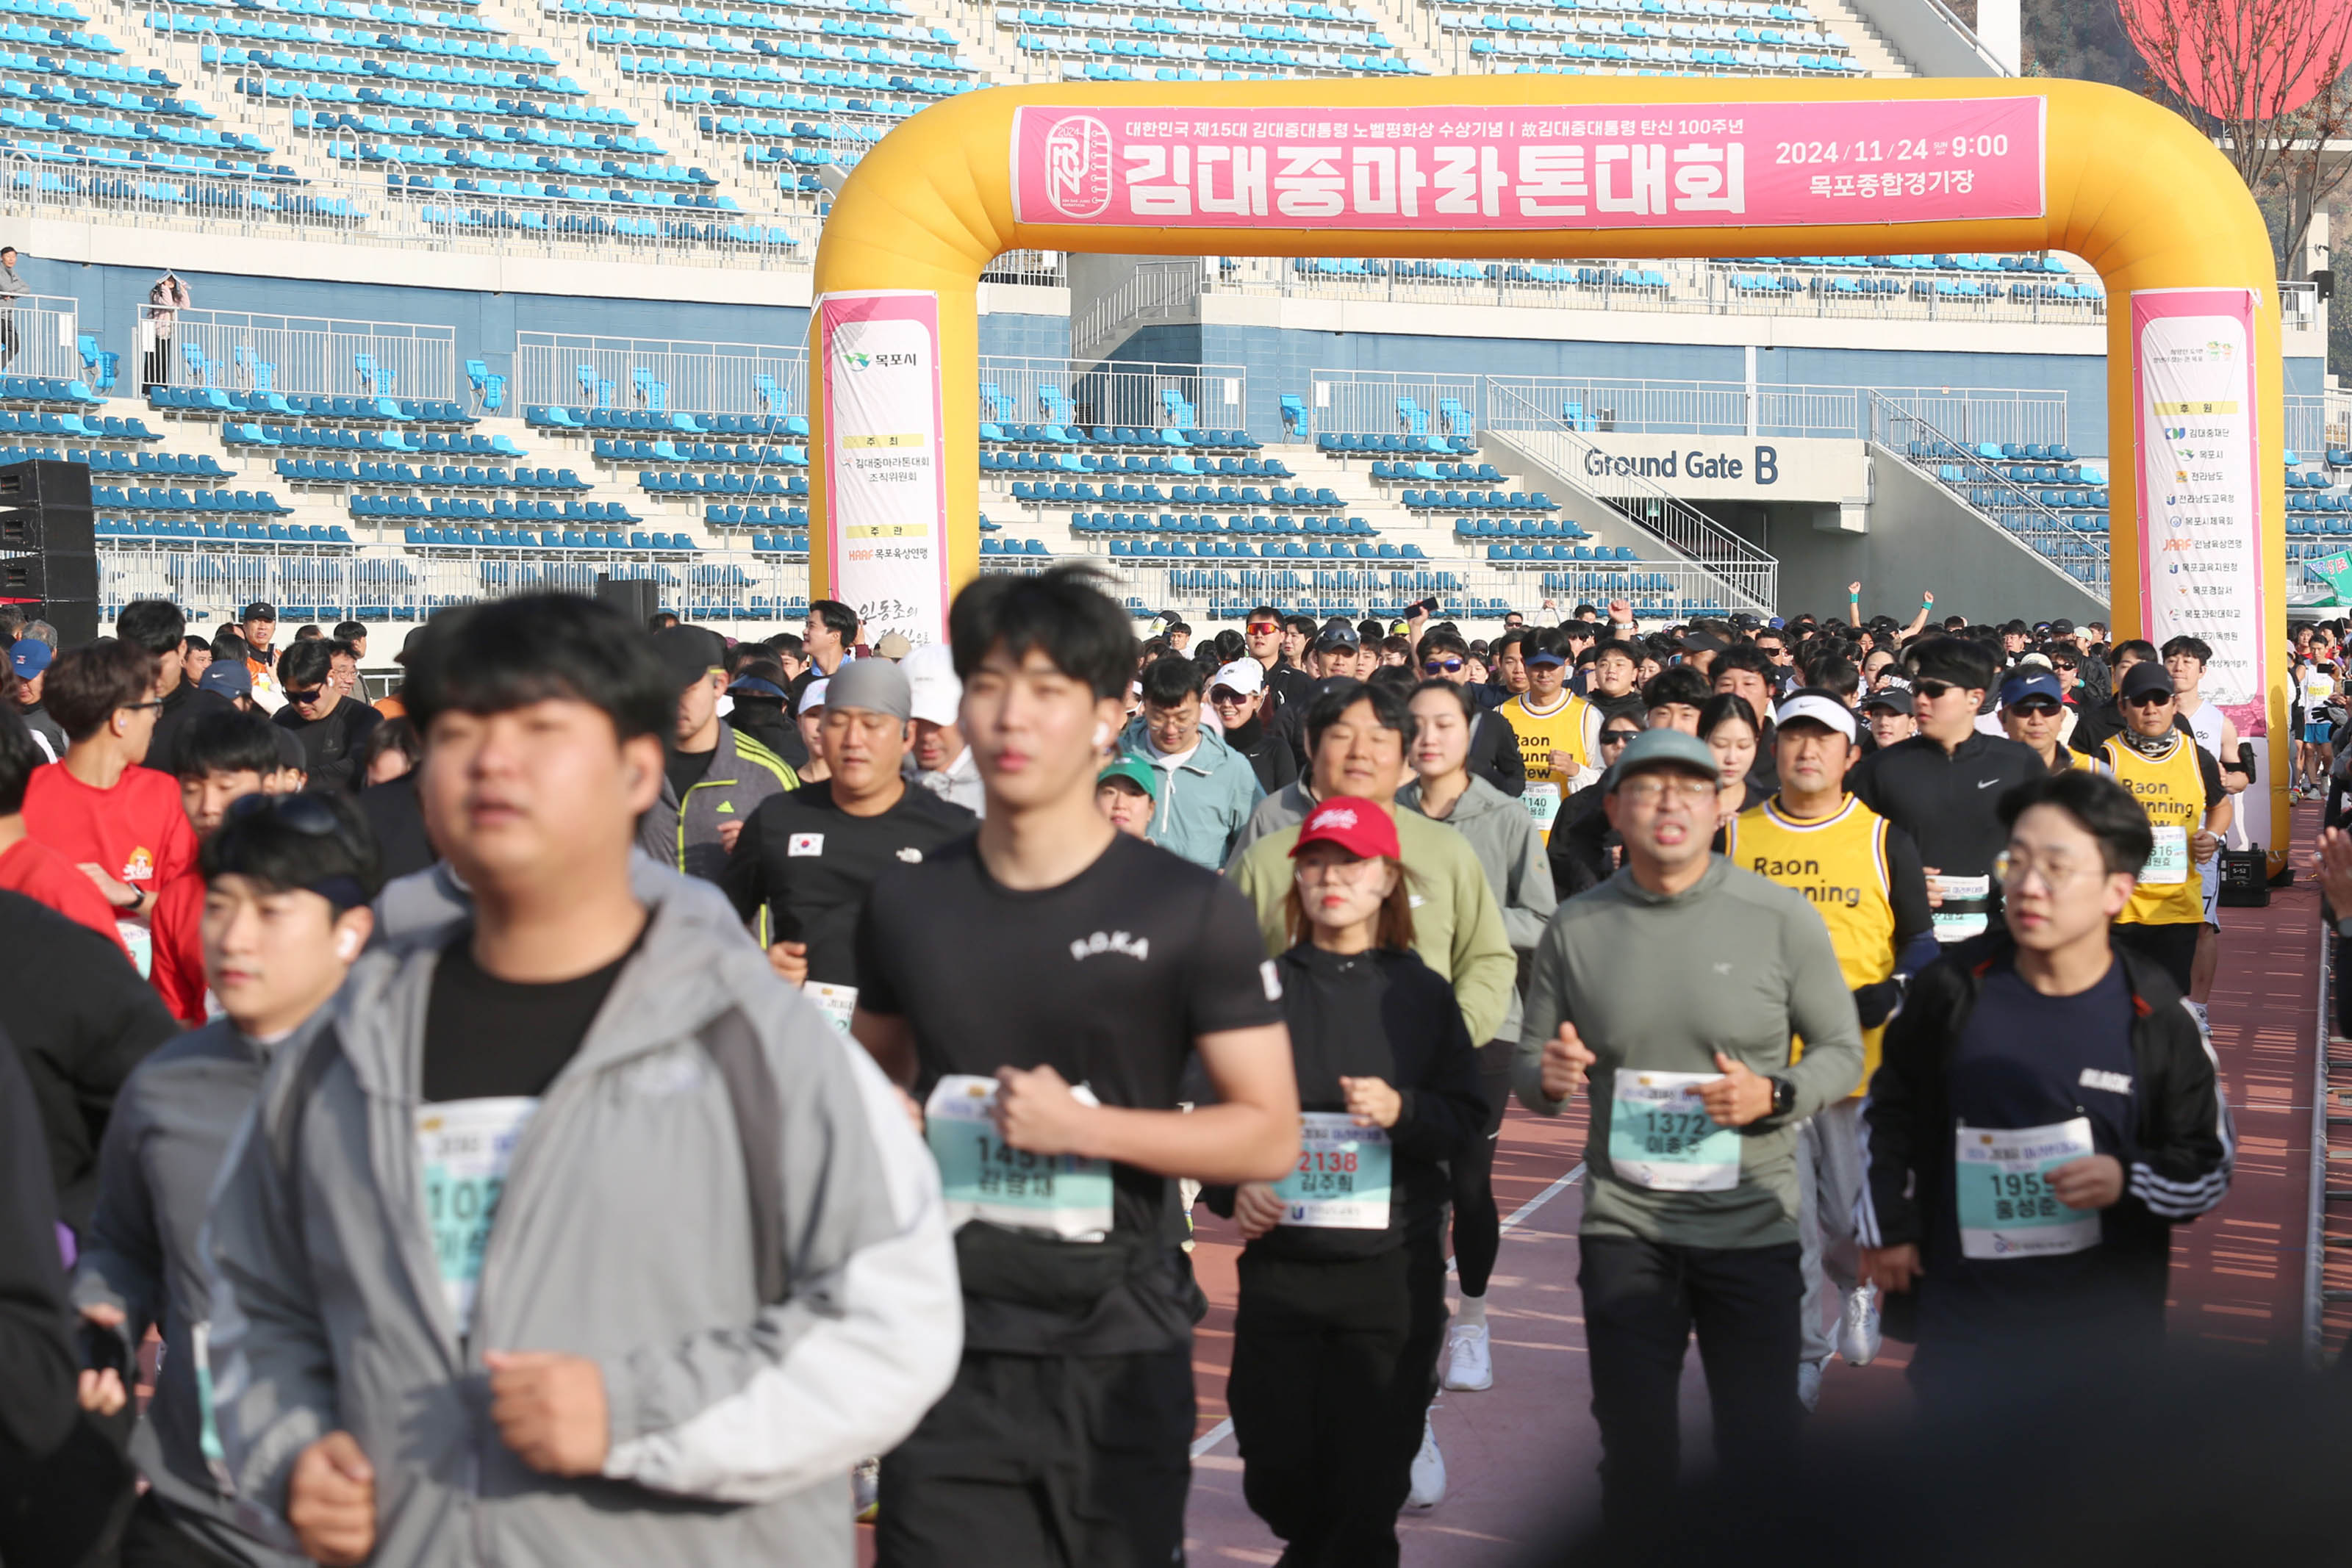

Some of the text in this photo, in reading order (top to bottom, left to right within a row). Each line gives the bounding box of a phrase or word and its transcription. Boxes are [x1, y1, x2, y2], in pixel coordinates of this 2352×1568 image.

[1125, 121, 1189, 137] 대한민국
[1194, 122, 1247, 137] 제15대
[1252, 122, 1348, 138] 김대중대통령
[1353, 122, 1435, 138] 노벨평화상
[1439, 121, 1503, 138] 수상기념
[1641, 120, 1673, 136] 탄신
[1678, 118, 1743, 135] 100주년
[1952, 134, 2008, 158] 9:00
[1123, 142, 1745, 217] 김대중마라톤대회
[1809, 169, 1975, 198] 목포종합경기장
[875, 353, 917, 367] 목포시
[2190, 428, 2230, 439] 김대중재단
[2199, 450, 2224, 460] 목포시
[856, 456, 930, 470] 김대중마라톤대회
[1585, 445, 1779, 485] Ground Gate B
[869, 471, 918, 483] 조직위원회
[2191, 471, 2224, 482] 전라남도
[2179, 494, 2235, 505] 전라남도교육청
[2184, 516, 2234, 526] 목포시체육회
[2195, 539, 2242, 550] 전남육상연맹
[875, 547, 928, 560] 목포육상연맹
[2182, 562, 2238, 572] 목포교육지원청
[2193, 585, 2232, 595] 목포경찰서
[858, 599, 918, 622] 인동초의
[2184, 609, 2241, 619] 목포과학대학교
[2122, 779, 2169, 794] Raon
[1754, 857, 1819, 877] Raon
[1646, 1112, 1706, 1135] 1372
[1299, 1150, 1359, 1173] 2138
